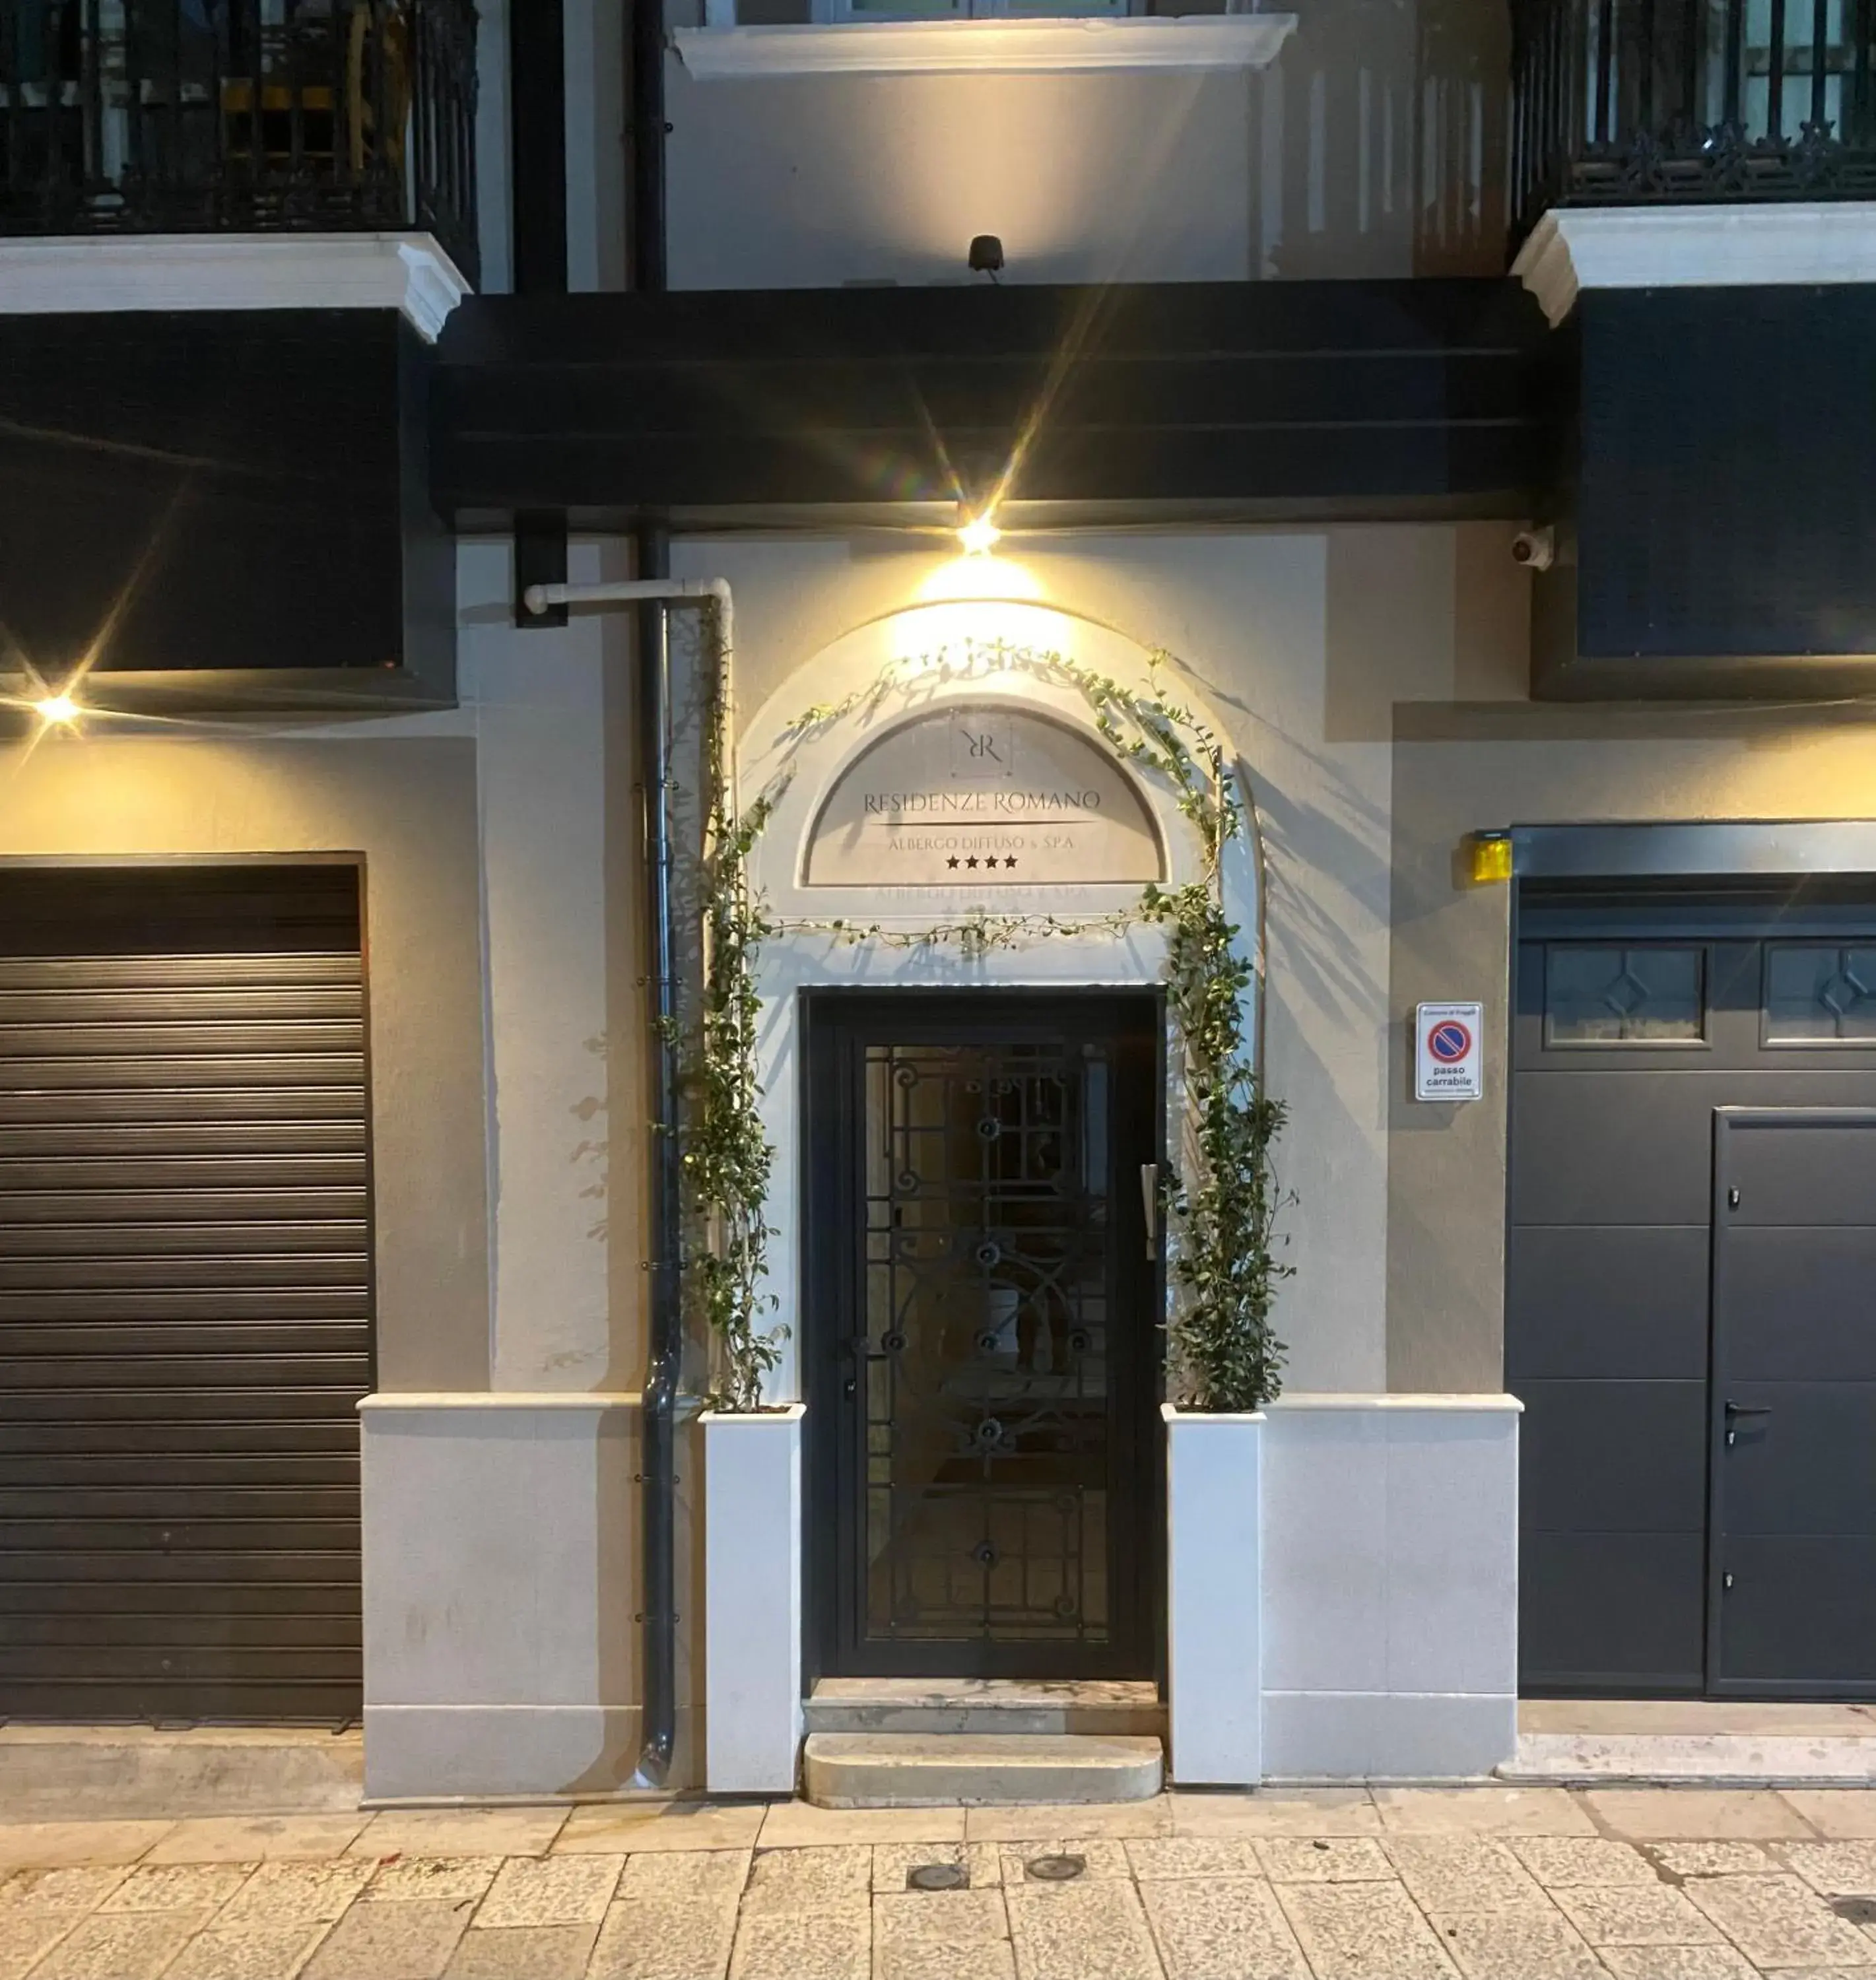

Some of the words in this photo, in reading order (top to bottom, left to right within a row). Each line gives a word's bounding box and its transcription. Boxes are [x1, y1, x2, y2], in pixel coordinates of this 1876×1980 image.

[863, 791, 988, 814] RESIDENZE
[993, 791, 1101, 814] ROMANO
[888, 836, 958, 850] ALBERGO
[1043, 836, 1074, 849] SPA
[1433, 1067, 1465, 1076] passo
[1426, 1076, 1472, 1086] carrabile
